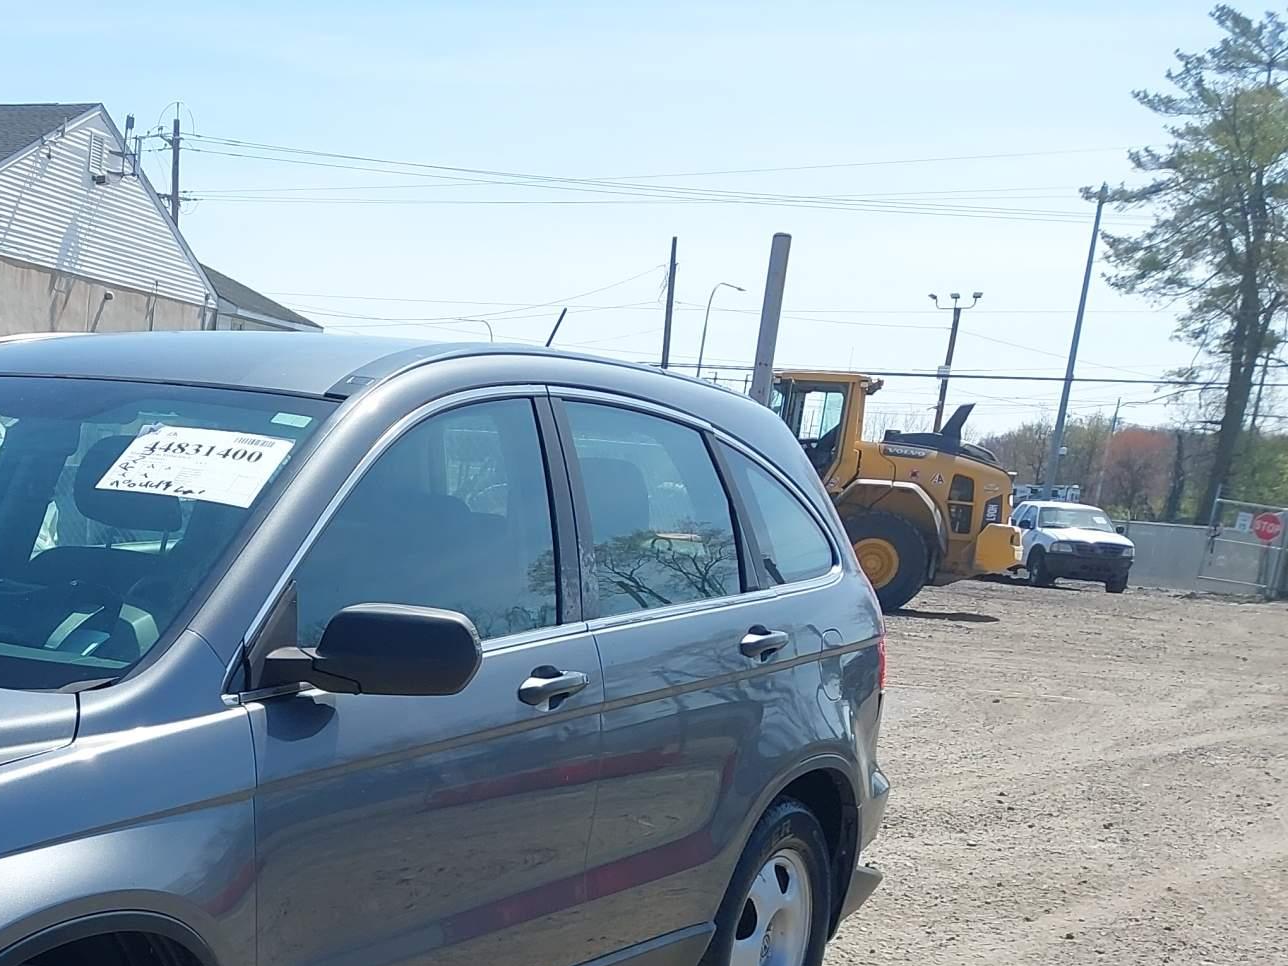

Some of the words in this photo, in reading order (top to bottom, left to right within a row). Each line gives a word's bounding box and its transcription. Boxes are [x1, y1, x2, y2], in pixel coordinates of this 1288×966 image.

[143, 439, 263, 464] 44831400
[887, 446, 927, 457] VOLVO
[1254, 519, 1282, 535] STOP
